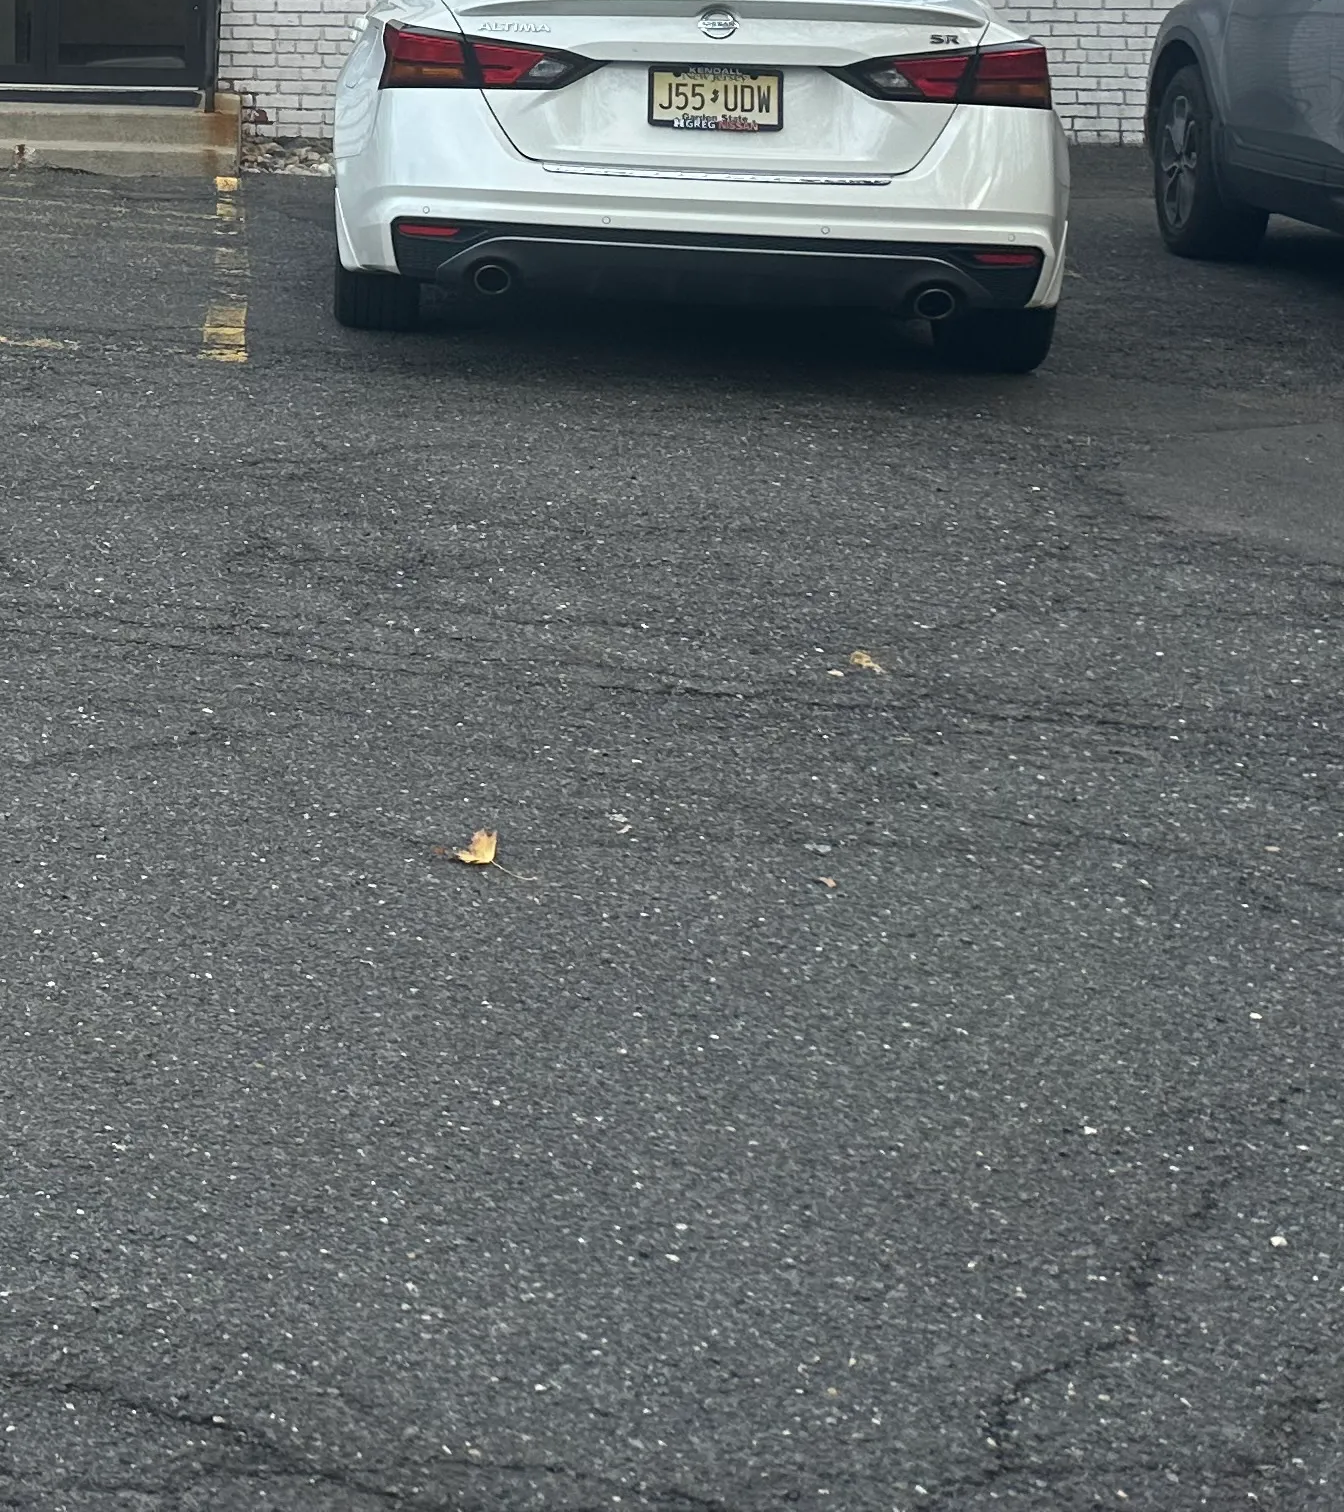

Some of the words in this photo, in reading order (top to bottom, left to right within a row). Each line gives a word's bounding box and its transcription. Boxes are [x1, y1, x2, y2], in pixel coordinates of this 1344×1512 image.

[477, 21, 552, 33] ALTIMA
[930, 34, 960, 45] SR
[688, 67, 743, 76] KENDALL
[658, 82, 705, 110] J55
[724, 84, 771, 113] UDW
[717, 120, 759, 131] NISSAN
